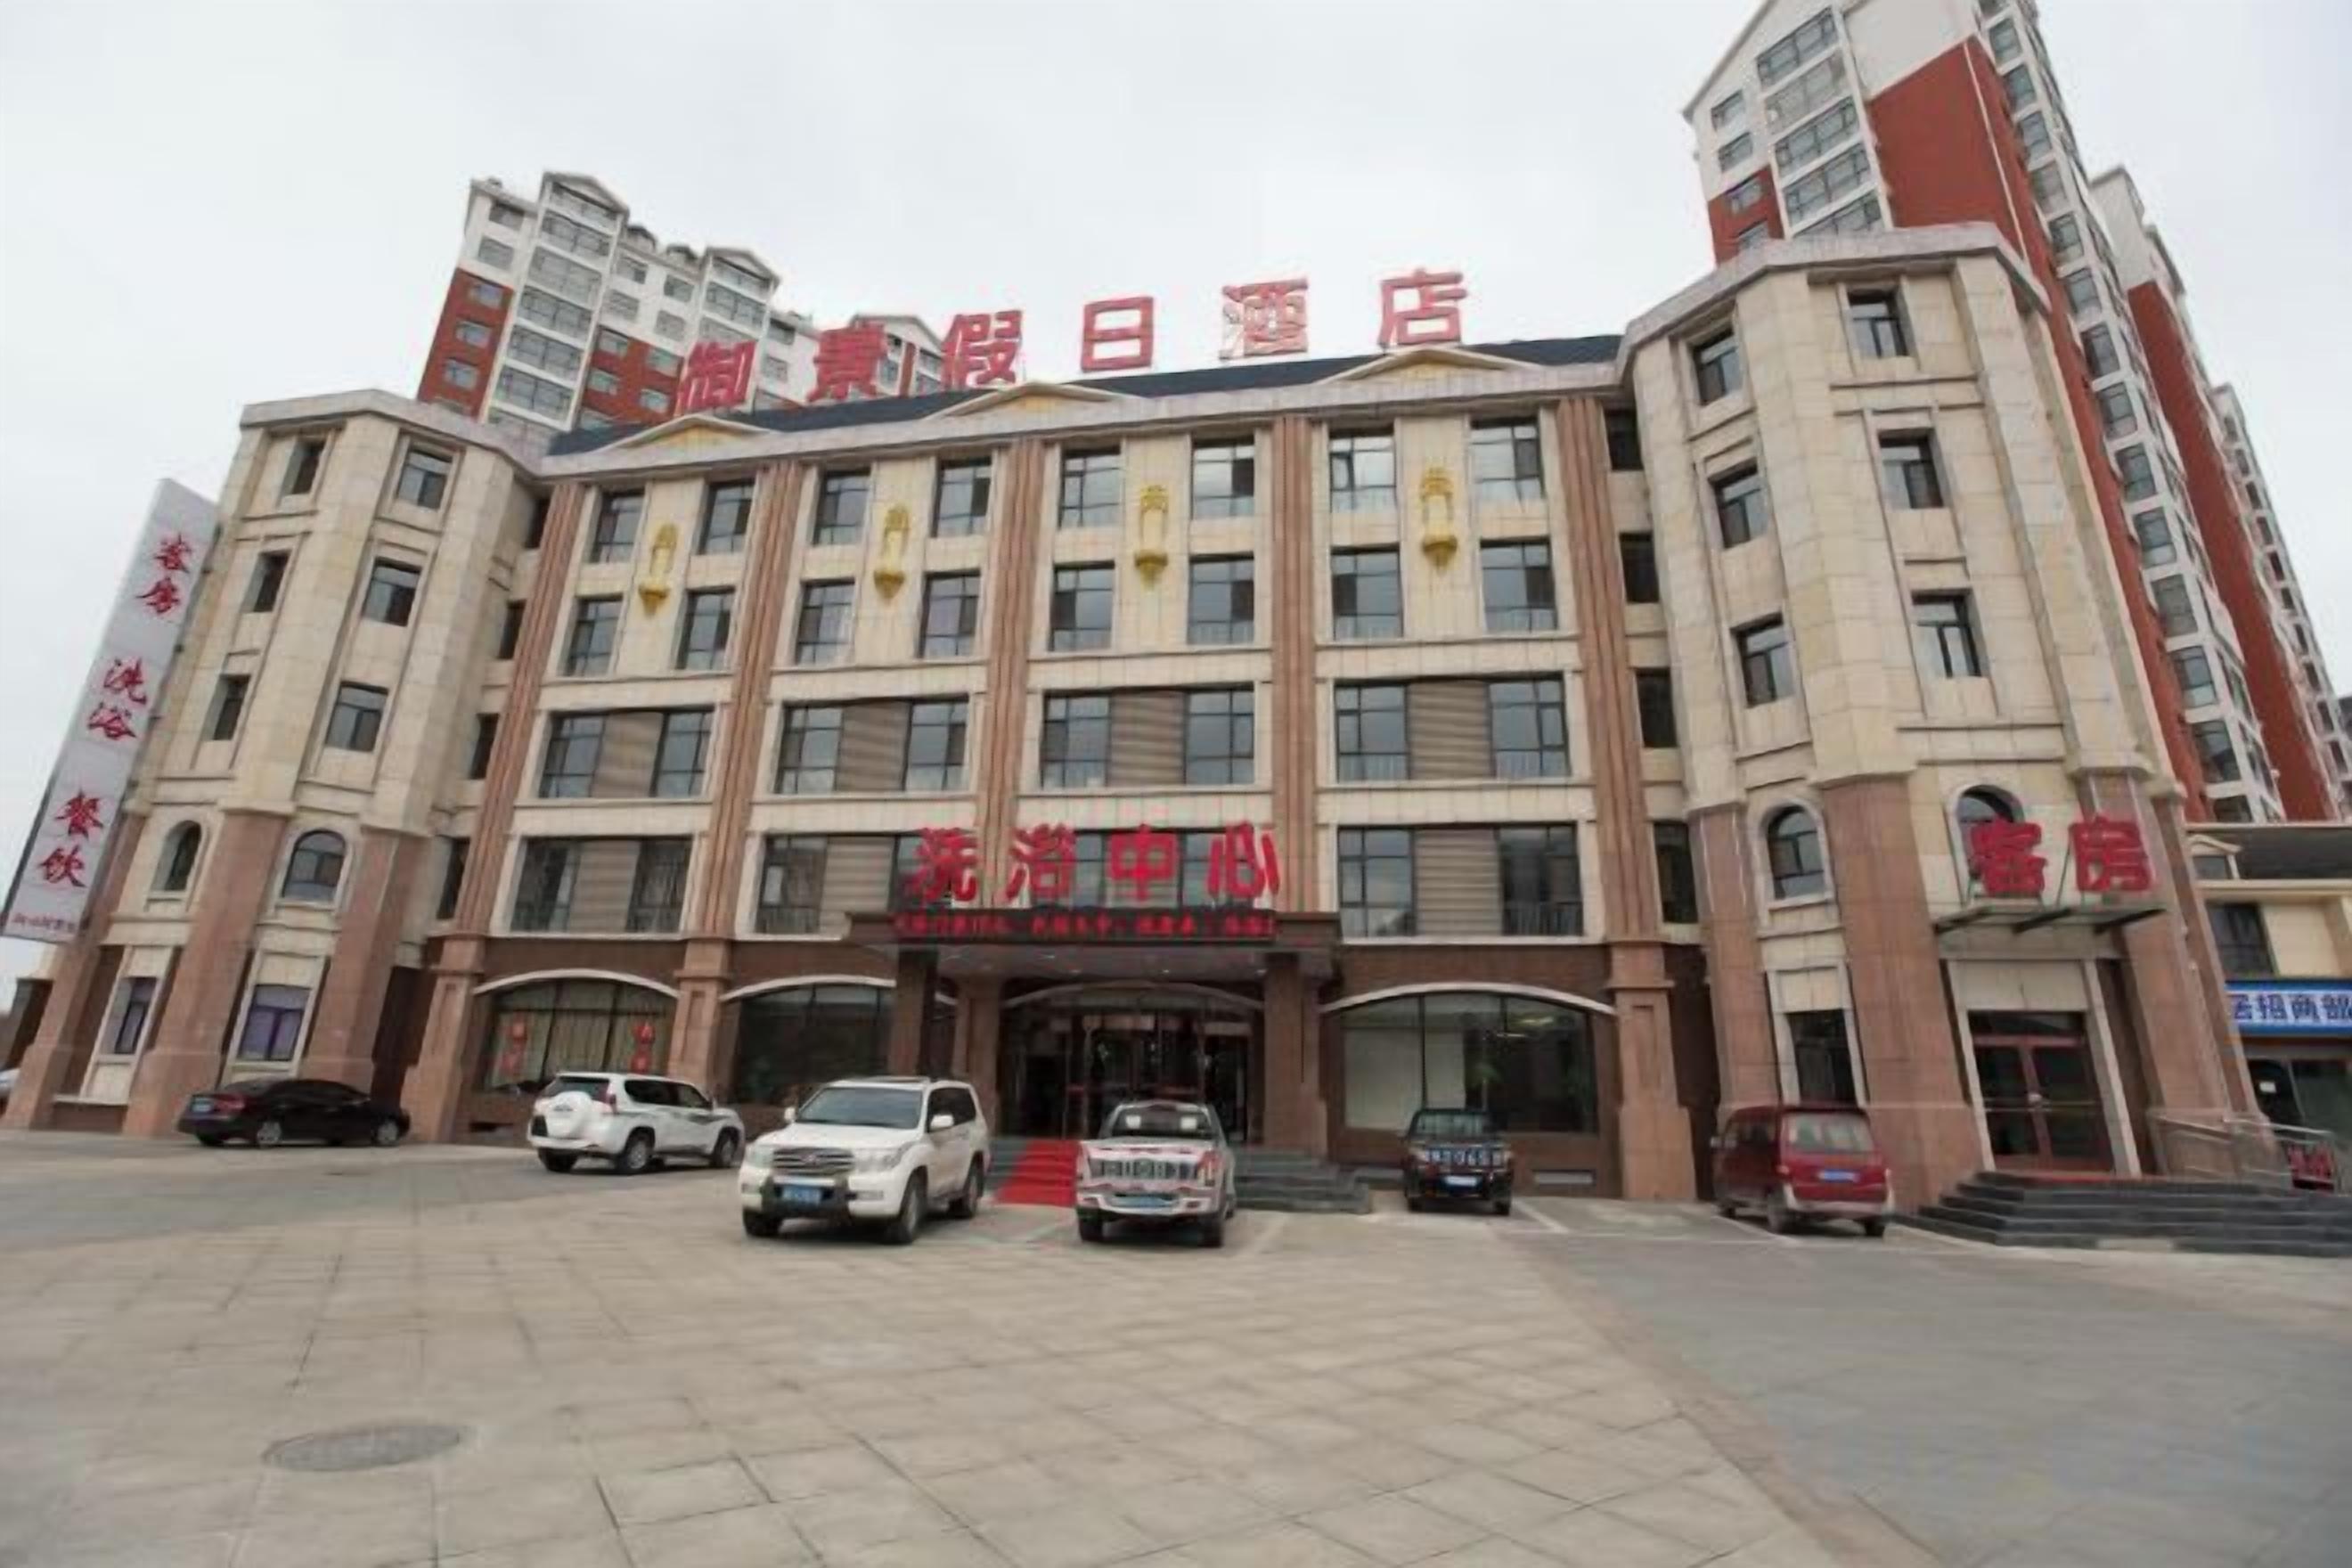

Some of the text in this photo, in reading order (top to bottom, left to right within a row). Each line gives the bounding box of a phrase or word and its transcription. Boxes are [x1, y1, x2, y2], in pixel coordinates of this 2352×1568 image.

[909, 822, 1280, 902] 洗浴中心
[1971, 817, 2152, 894] 客房
